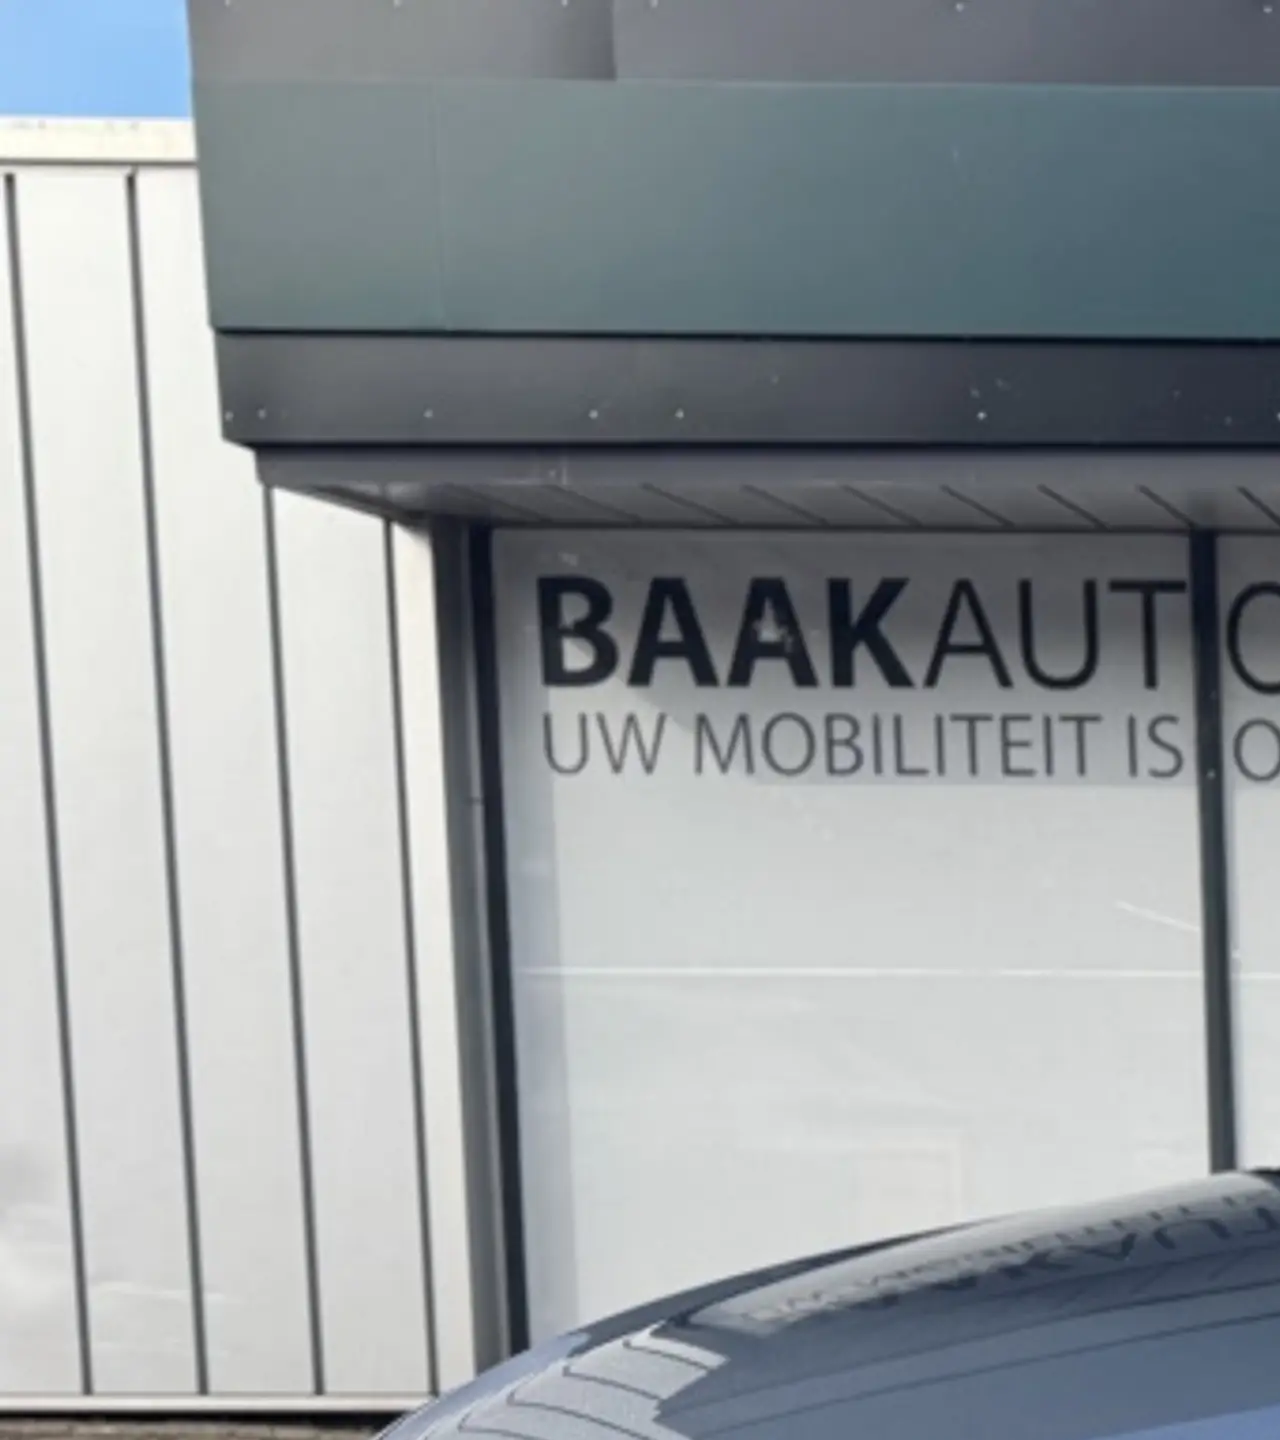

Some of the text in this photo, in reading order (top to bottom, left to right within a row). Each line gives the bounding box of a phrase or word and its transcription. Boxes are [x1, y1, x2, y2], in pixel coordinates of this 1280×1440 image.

[543, 712, 667, 776] UW
[694, 712, 1104, 777] MOBILITEIT
[1128, 714, 1186, 779] IS
